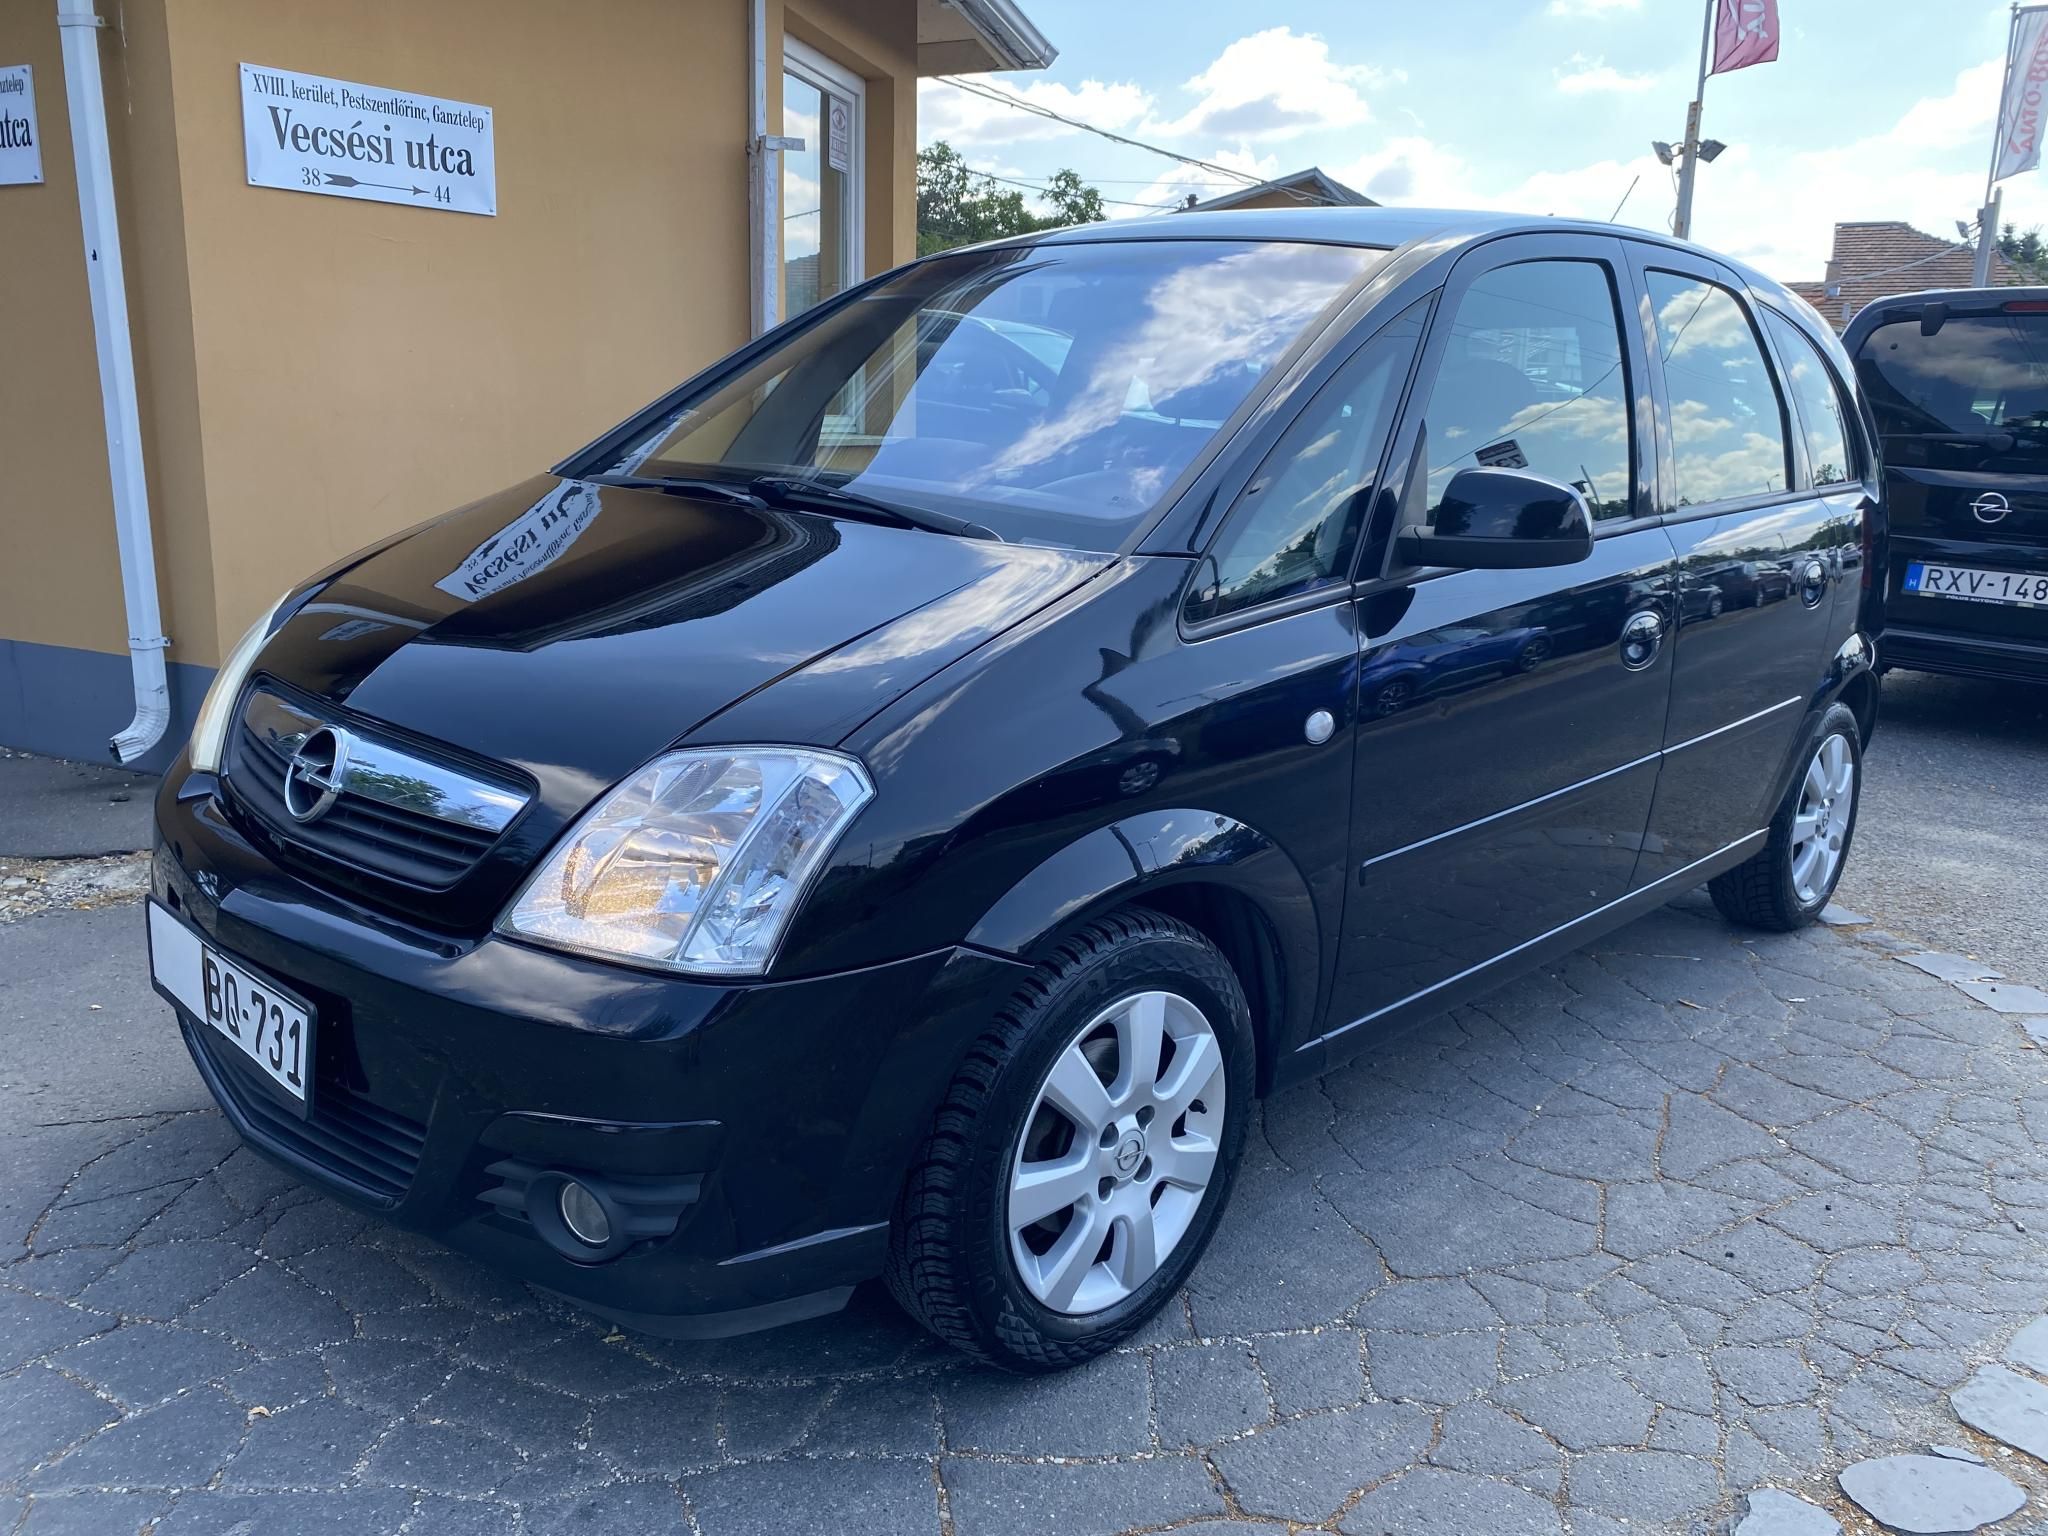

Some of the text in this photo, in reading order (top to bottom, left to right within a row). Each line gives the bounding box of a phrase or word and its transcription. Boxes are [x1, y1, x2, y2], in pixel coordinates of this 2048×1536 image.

[0, 72, 24, 96] ztelep
[252, 73, 484, 133] XVIII. kerület, Pestszentlőrinc, Ganztelep
[266, 104, 476, 177] Vecsési utca
[301, 166, 452, 204] 38 44
[1908, 578, 1918, 588] H
[1924, 568, 2048, 601] RXV-148
[205, 956, 302, 1089] BQ-731
